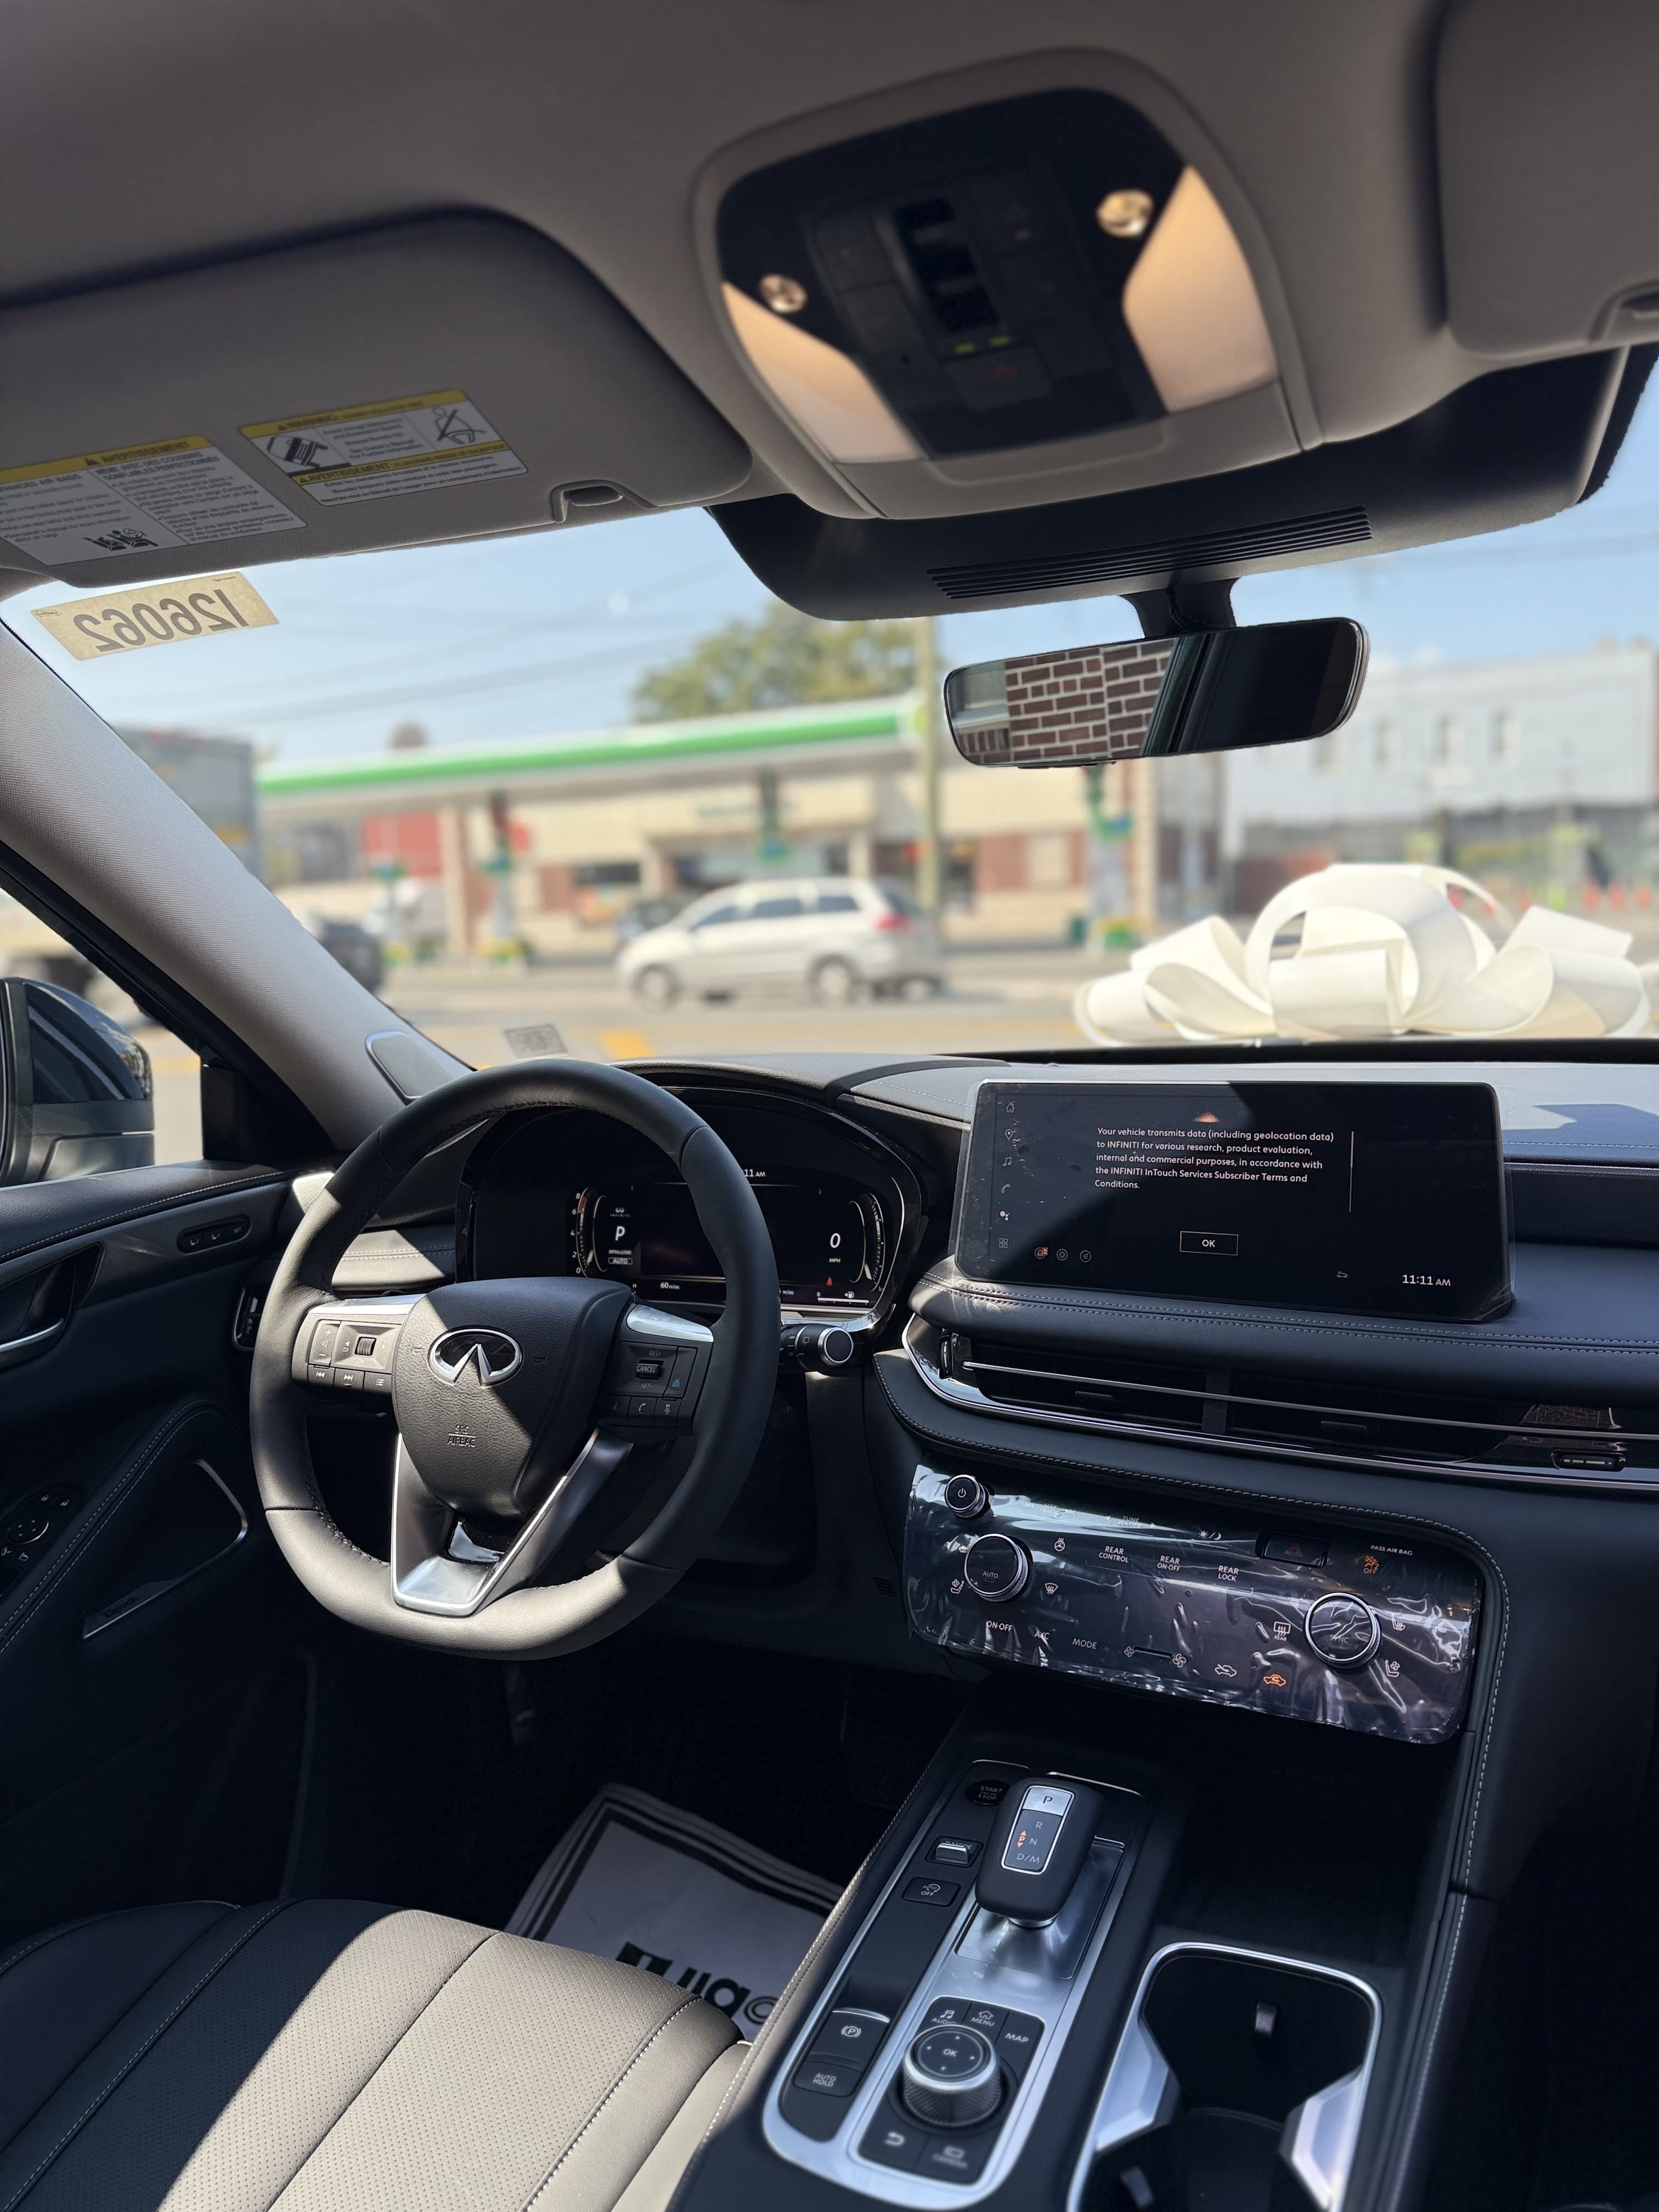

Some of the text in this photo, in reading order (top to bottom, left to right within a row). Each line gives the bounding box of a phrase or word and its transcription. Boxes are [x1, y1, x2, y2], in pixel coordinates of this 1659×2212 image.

[1098, 1127, 1334, 1142] Your vehicle transmits data (including geolocation data)
[1107, 1141, 1139, 1149] INFINITI
[1141, 1141, 1154, 1149] for
[1187, 1143, 1224, 1153] research,
[1226, 1144, 1261, 1154] product
[1263, 1146, 1313, 1155] evaluation,
[1096, 1153, 1127, 1161] internal
[1196, 1159, 1237, 1167] purposes,
[1239, 1158, 1248, 1166] in
[1249, 1159, 1300, 1168] accordance
[1302, 1160, 1323, 1169] with
[1110, 1167, 1143, 1176] INFINITI
[1145, 1168, 1177, 1177] InTouch
[1179, 1170, 1212, 1178] Services
[1214, 1171, 1260, 1180] Subscriber
[1261, 1173, 1288, 1182] Terms
[1290, 1174, 1307, 1182] and
[1094, 1180, 1140, 1189] Conditions.
[615, 1226, 625, 1241] P
[830, 1233, 841, 1249] 0
[1201, 1239, 1216, 1248] OK
[1402, 1274, 1451, 1286] 11:11 AM
[1104, 1545, 1124, 1555] REAR
[1098, 1552, 1130, 1563] CONTROL
[1160, 1555, 1180, 1565] REAR
[983, 1571, 999, 1579] AUTO
[1218, 1565, 1239, 1575] REAR
[1218, 1573, 1237, 1582] LOCK
[1072, 1638, 1097, 1650] MODE
[1043, 1796, 1053, 1804] P
[1035, 1821, 1043, 1830] R
[1017, 1853, 1040, 1864] D/M
[921, 1888, 935, 1896] OFF
[970, 2017, 996, 2027] MENU
[1005, 2033, 1029, 2042] MAP
[943, 2048, 958, 2057] OK
[812, 2078, 834, 2087] HOLD
[815, 2073, 837, 2082] AUTO
